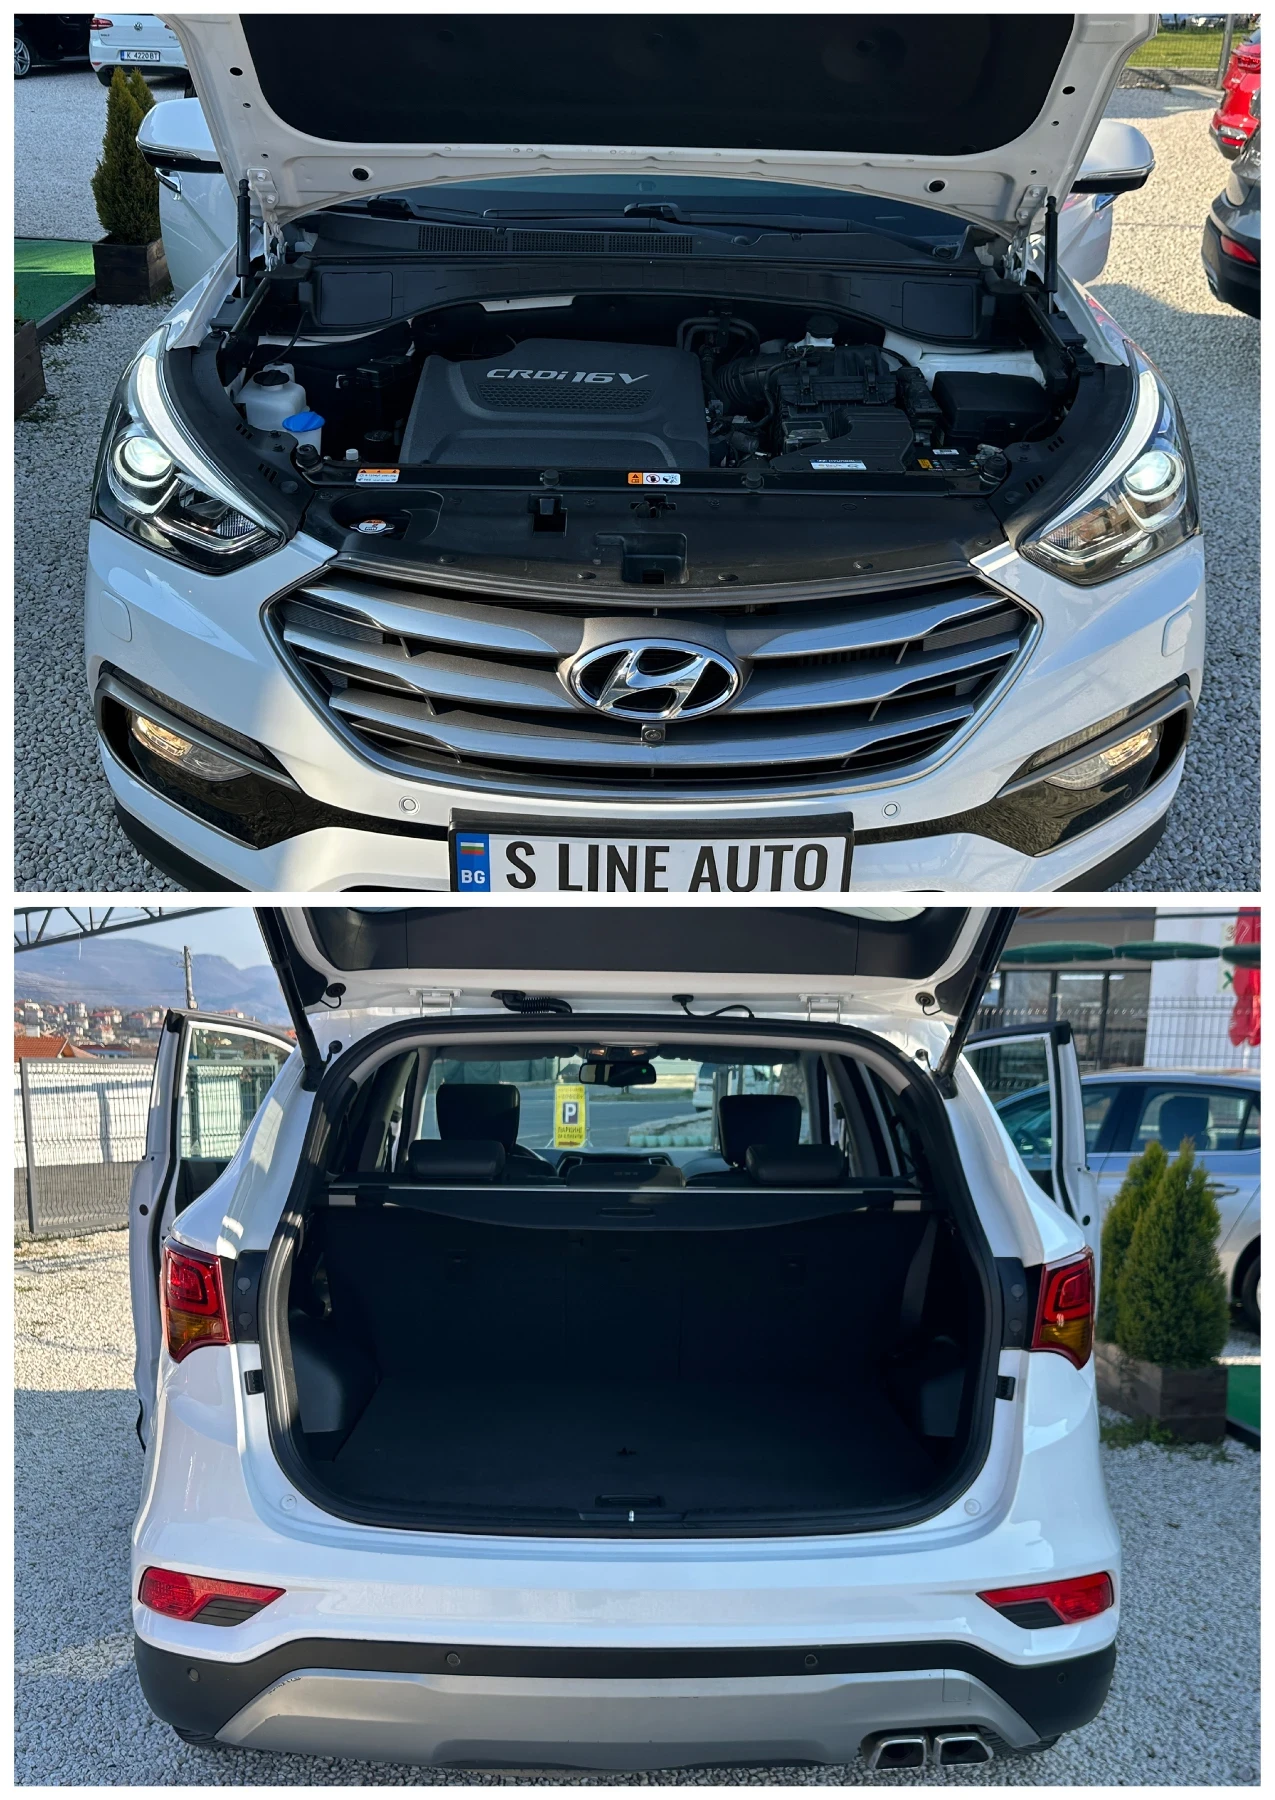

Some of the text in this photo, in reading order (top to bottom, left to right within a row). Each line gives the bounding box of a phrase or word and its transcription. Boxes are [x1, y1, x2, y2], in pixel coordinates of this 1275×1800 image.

[486, 369, 650, 385] CRDi 16V
[506, 841, 828, 892] S LINE AUTO
[461, 870, 486, 884] BG
[565, 1103, 577, 1123] P
